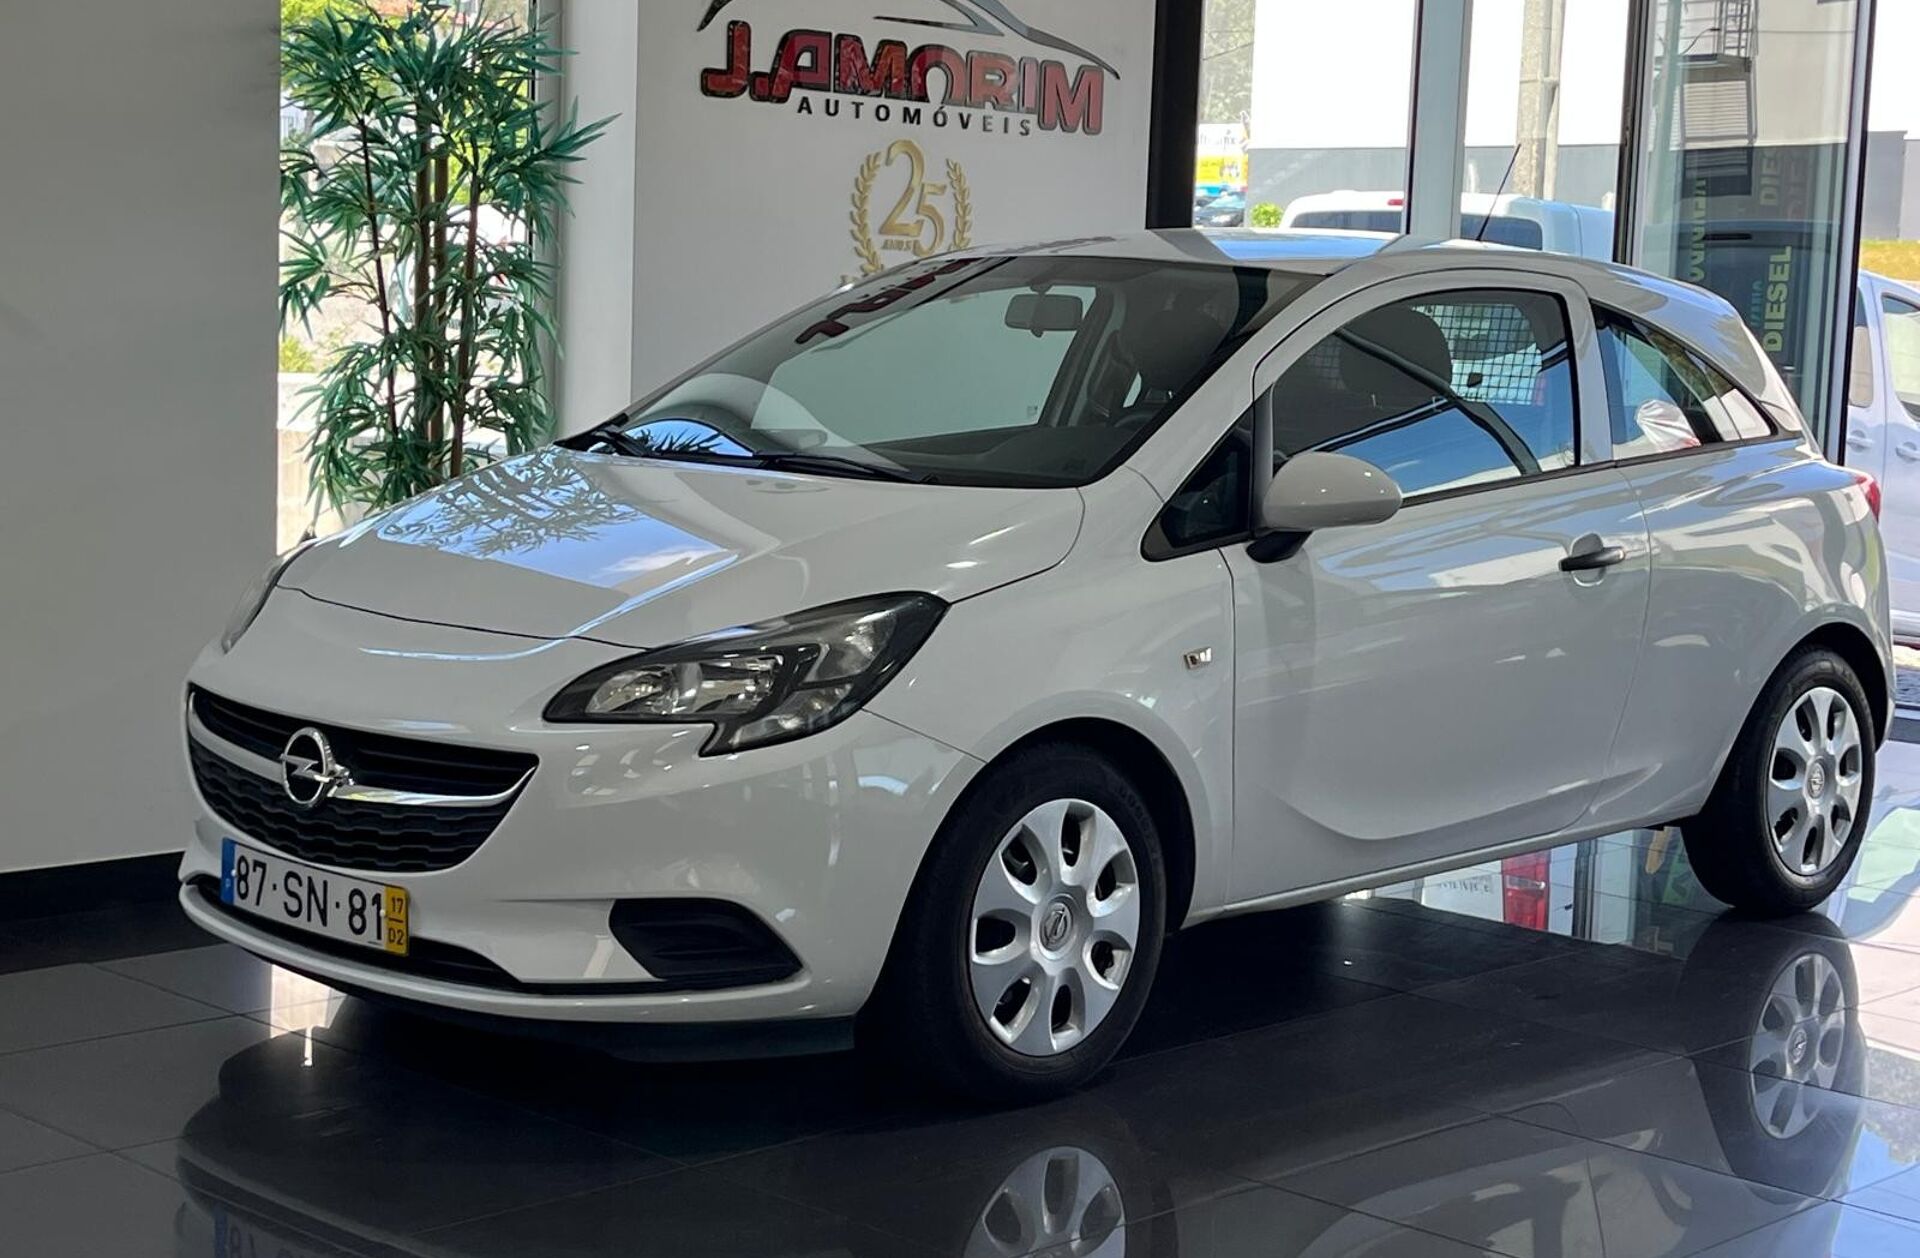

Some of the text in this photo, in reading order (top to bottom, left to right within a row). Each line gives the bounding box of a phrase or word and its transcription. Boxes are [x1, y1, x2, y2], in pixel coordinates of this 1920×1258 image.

[701, 20, 1105, 135] J.AMORIM
[797, 96, 1031, 137] AUTOMÓVEIS
[879, 139, 947, 257] 25
[1763, 246, 1792, 352] DIESEL
[389, 927, 405, 946] 02
[391, 896, 405, 912] 17
